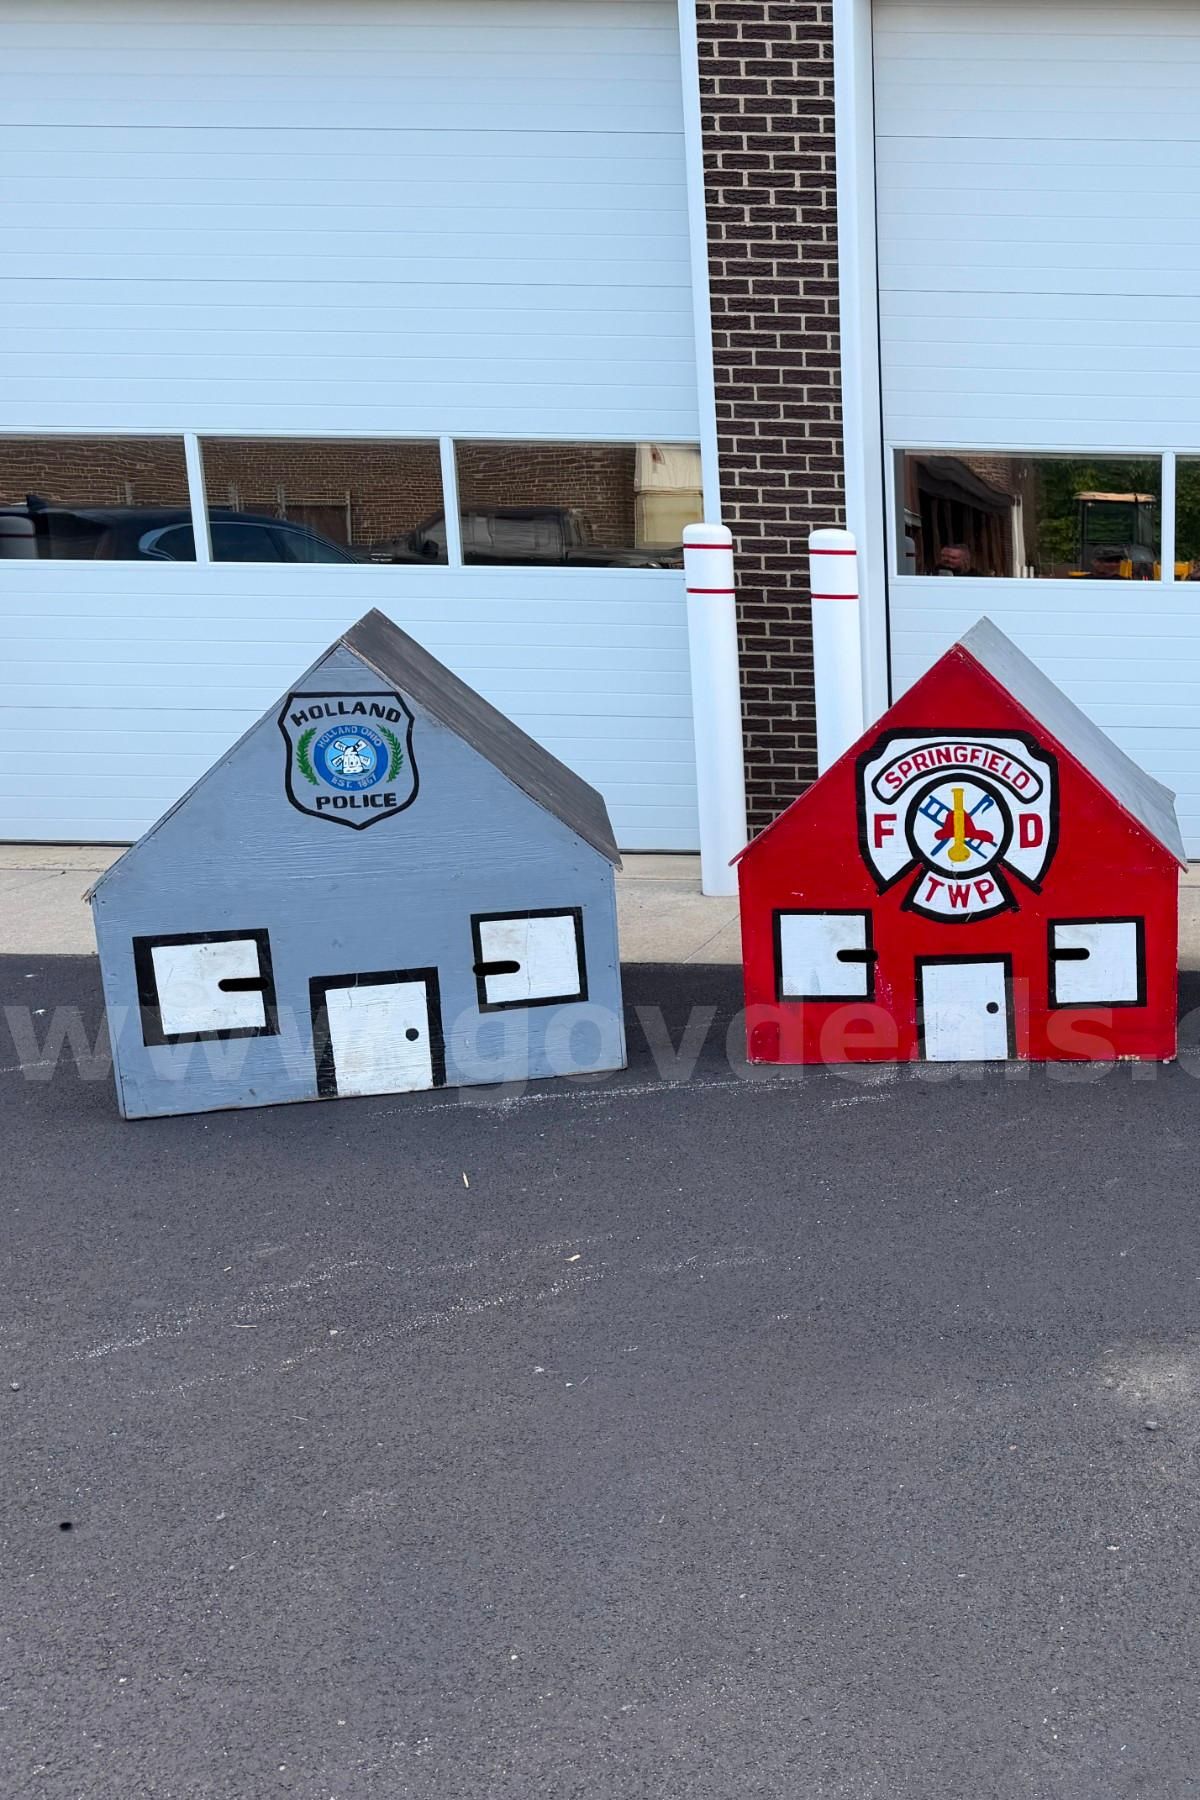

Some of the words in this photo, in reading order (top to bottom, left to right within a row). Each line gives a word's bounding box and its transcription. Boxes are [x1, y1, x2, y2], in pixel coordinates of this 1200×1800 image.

[290, 701, 402, 727] HOLLAND
[317, 726, 358, 748] HOLLAND
[360, 727, 382, 747] OHIO
[884, 746, 1031, 790] SPRINGFIELD
[316, 792, 398, 811] POLICE
[873, 813, 897, 849] F
[1018, 813, 1044, 849] D
[925, 876, 995, 908] TWP
